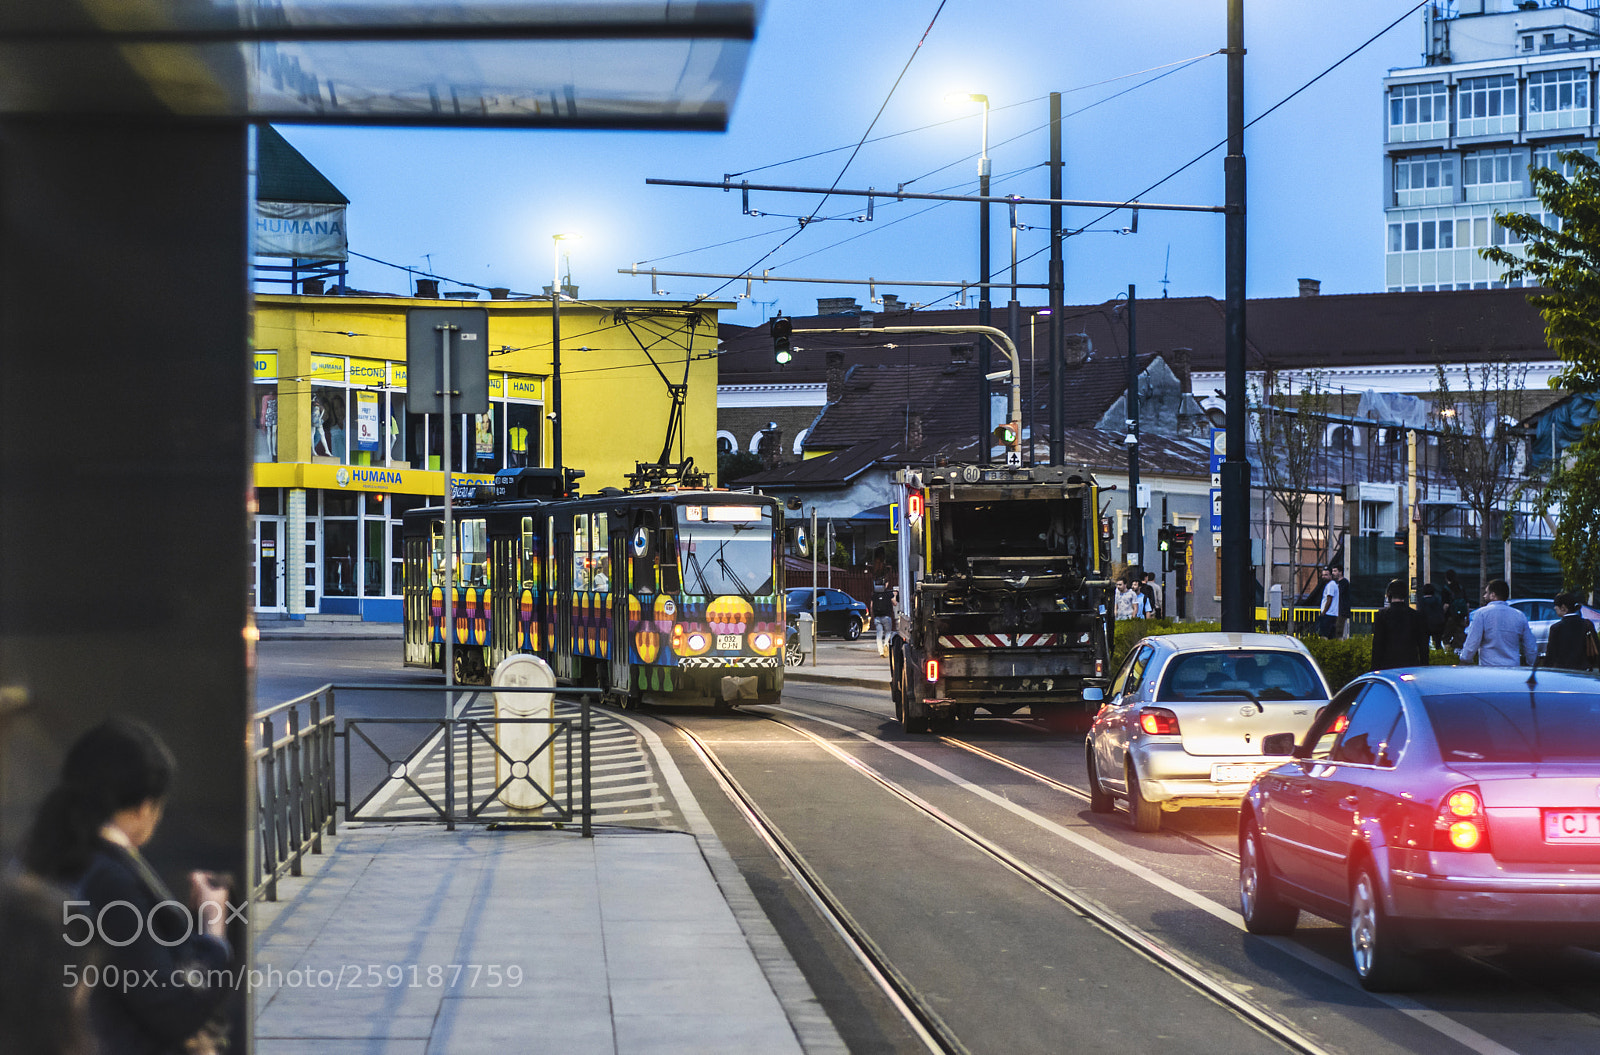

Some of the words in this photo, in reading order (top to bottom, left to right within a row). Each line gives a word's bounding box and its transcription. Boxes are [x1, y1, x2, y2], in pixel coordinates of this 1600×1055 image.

[256, 218, 342, 236] HUMANA
[252, 360, 267, 371] ND
[349, 366, 386, 378] SECOND
[395, 370, 407, 380] HA
[513, 382, 535, 392] HAND
[352, 469, 403, 484] HUMANA
[966, 468, 978, 480] 80
[723, 635, 737, 643] 032
[1562, 814, 1587, 834] CJ
